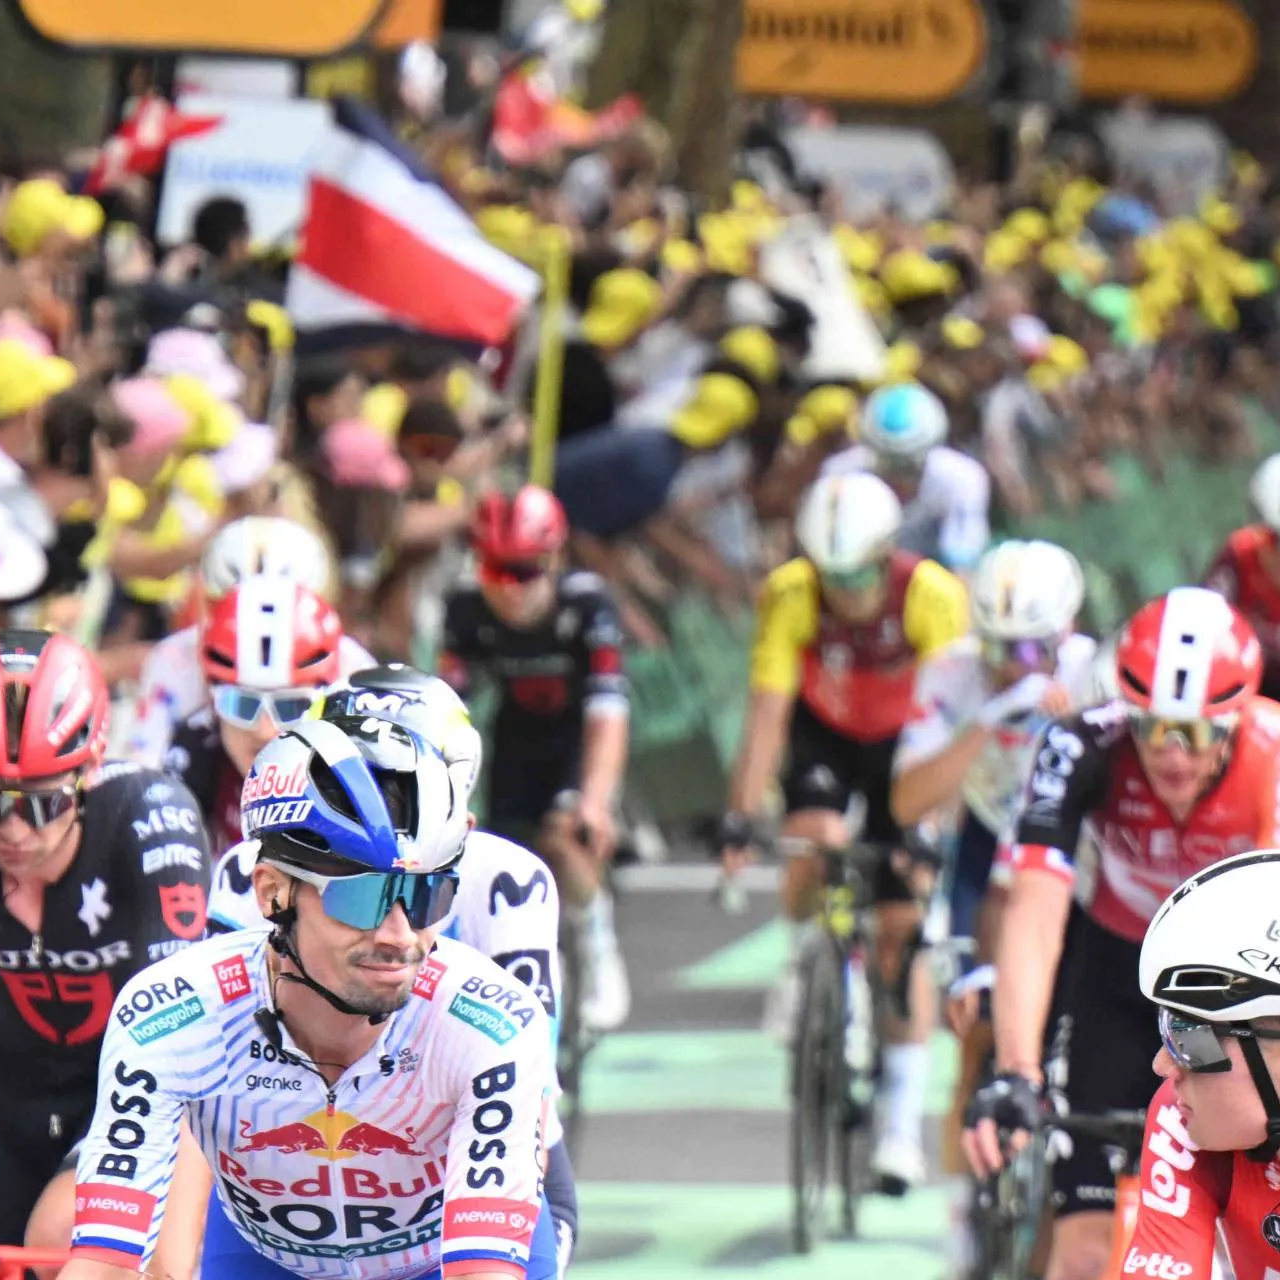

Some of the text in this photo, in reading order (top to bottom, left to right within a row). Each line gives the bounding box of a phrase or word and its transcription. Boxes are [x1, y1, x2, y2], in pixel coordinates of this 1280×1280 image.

[131, 806, 198, 841] MSC
[116, 976, 195, 1028] BORA
[222, 979, 247, 996] TAL
[461, 976, 535, 1029] BORA
[131, 1002, 202, 1041] hansgrohe
[453, 1000, 515, 1041] hansgrohe
[246, 1073, 302, 1092] grenke
[96, 1060, 158, 1180] BOSS
[466, 1061, 516, 1190] BOSS
[219, 1150, 332, 1198] Red
[221, 1175, 445, 1242] BORA
